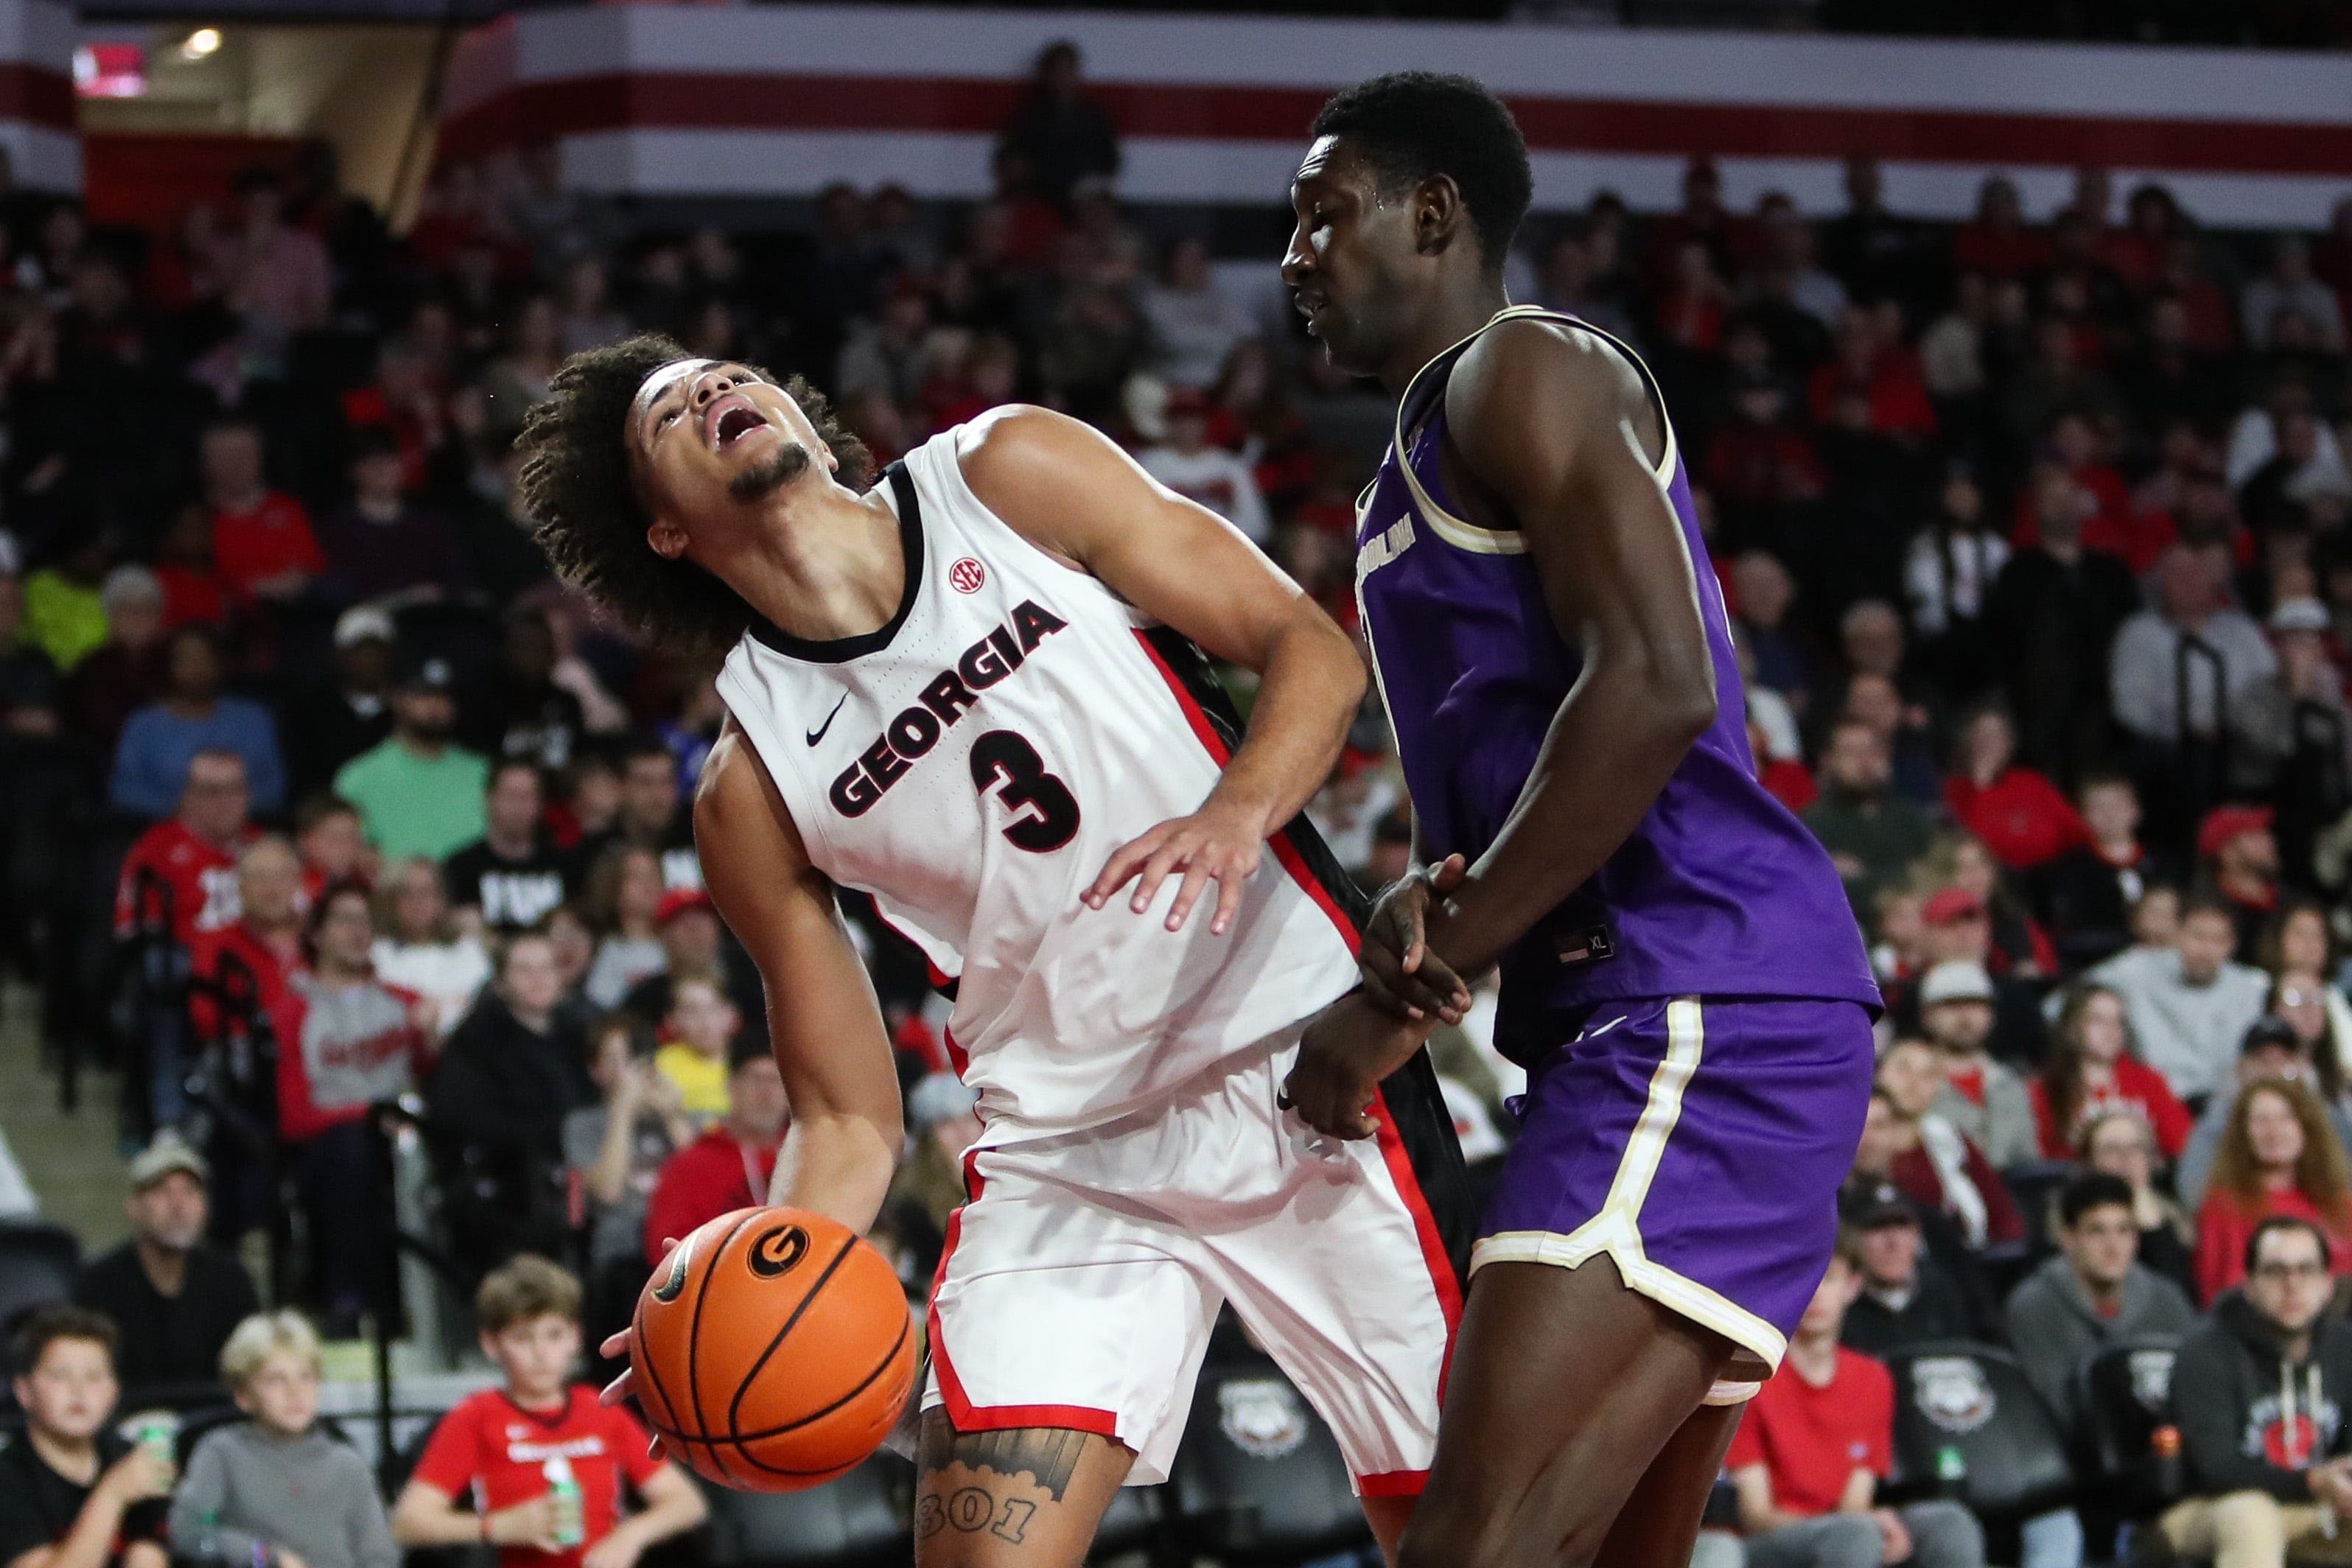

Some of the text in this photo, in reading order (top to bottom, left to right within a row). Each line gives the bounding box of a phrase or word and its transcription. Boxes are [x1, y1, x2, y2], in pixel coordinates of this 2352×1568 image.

[952, 560, 982, 591] SEC
[829, 599, 1069, 818] GEORGIA
[970, 729, 1081, 853] 3
[1588, 935, 1607, 951] XL
[917, 1486, 1037, 1545] 301
